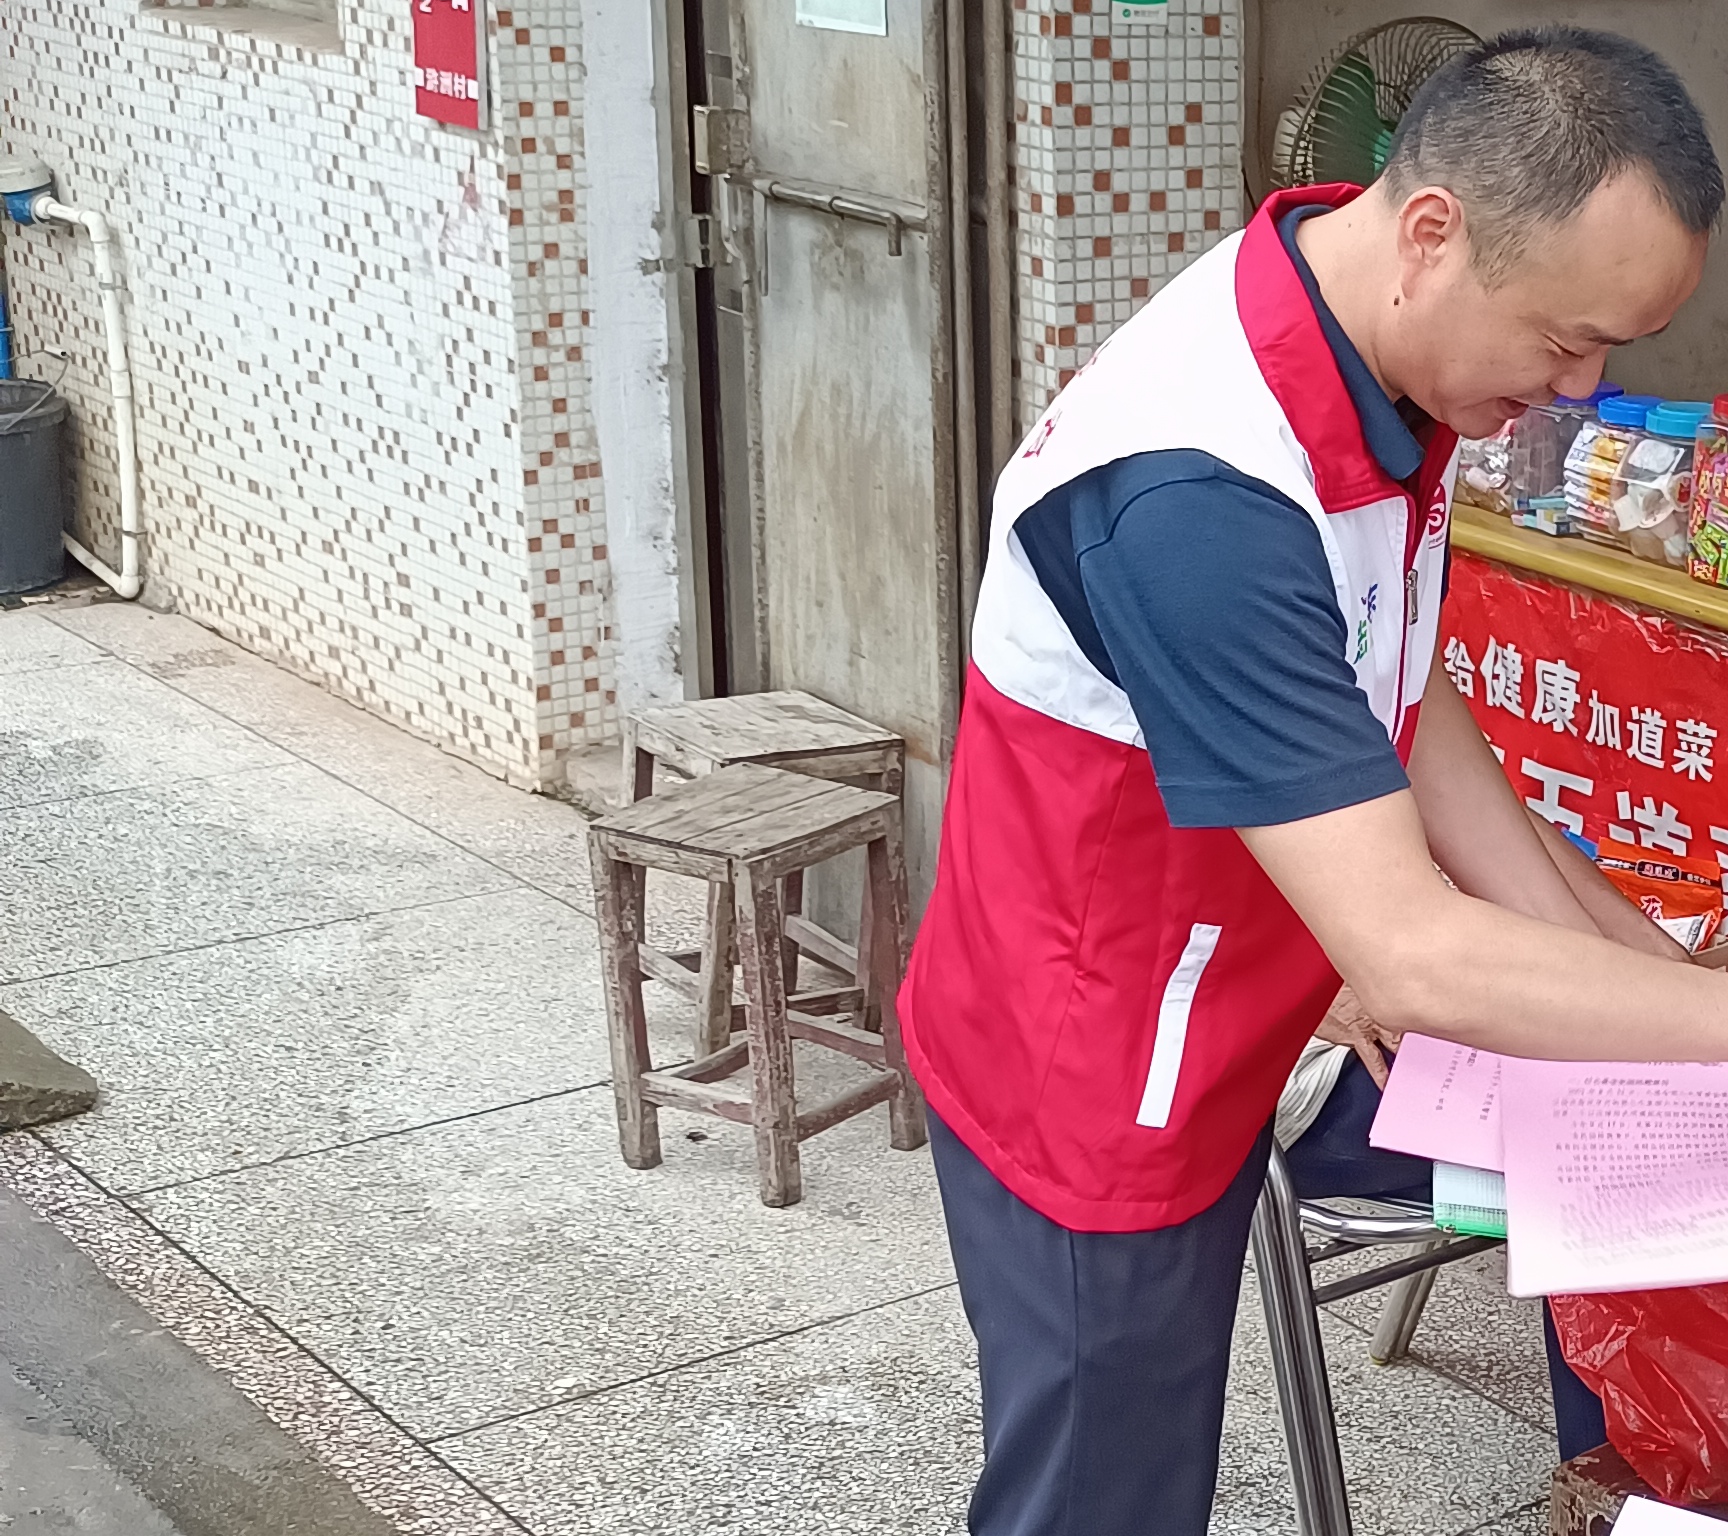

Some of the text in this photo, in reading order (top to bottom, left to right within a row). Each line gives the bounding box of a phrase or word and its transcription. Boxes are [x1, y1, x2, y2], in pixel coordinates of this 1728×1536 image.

[1444, 634, 1718, 783] 给健康加道菜
